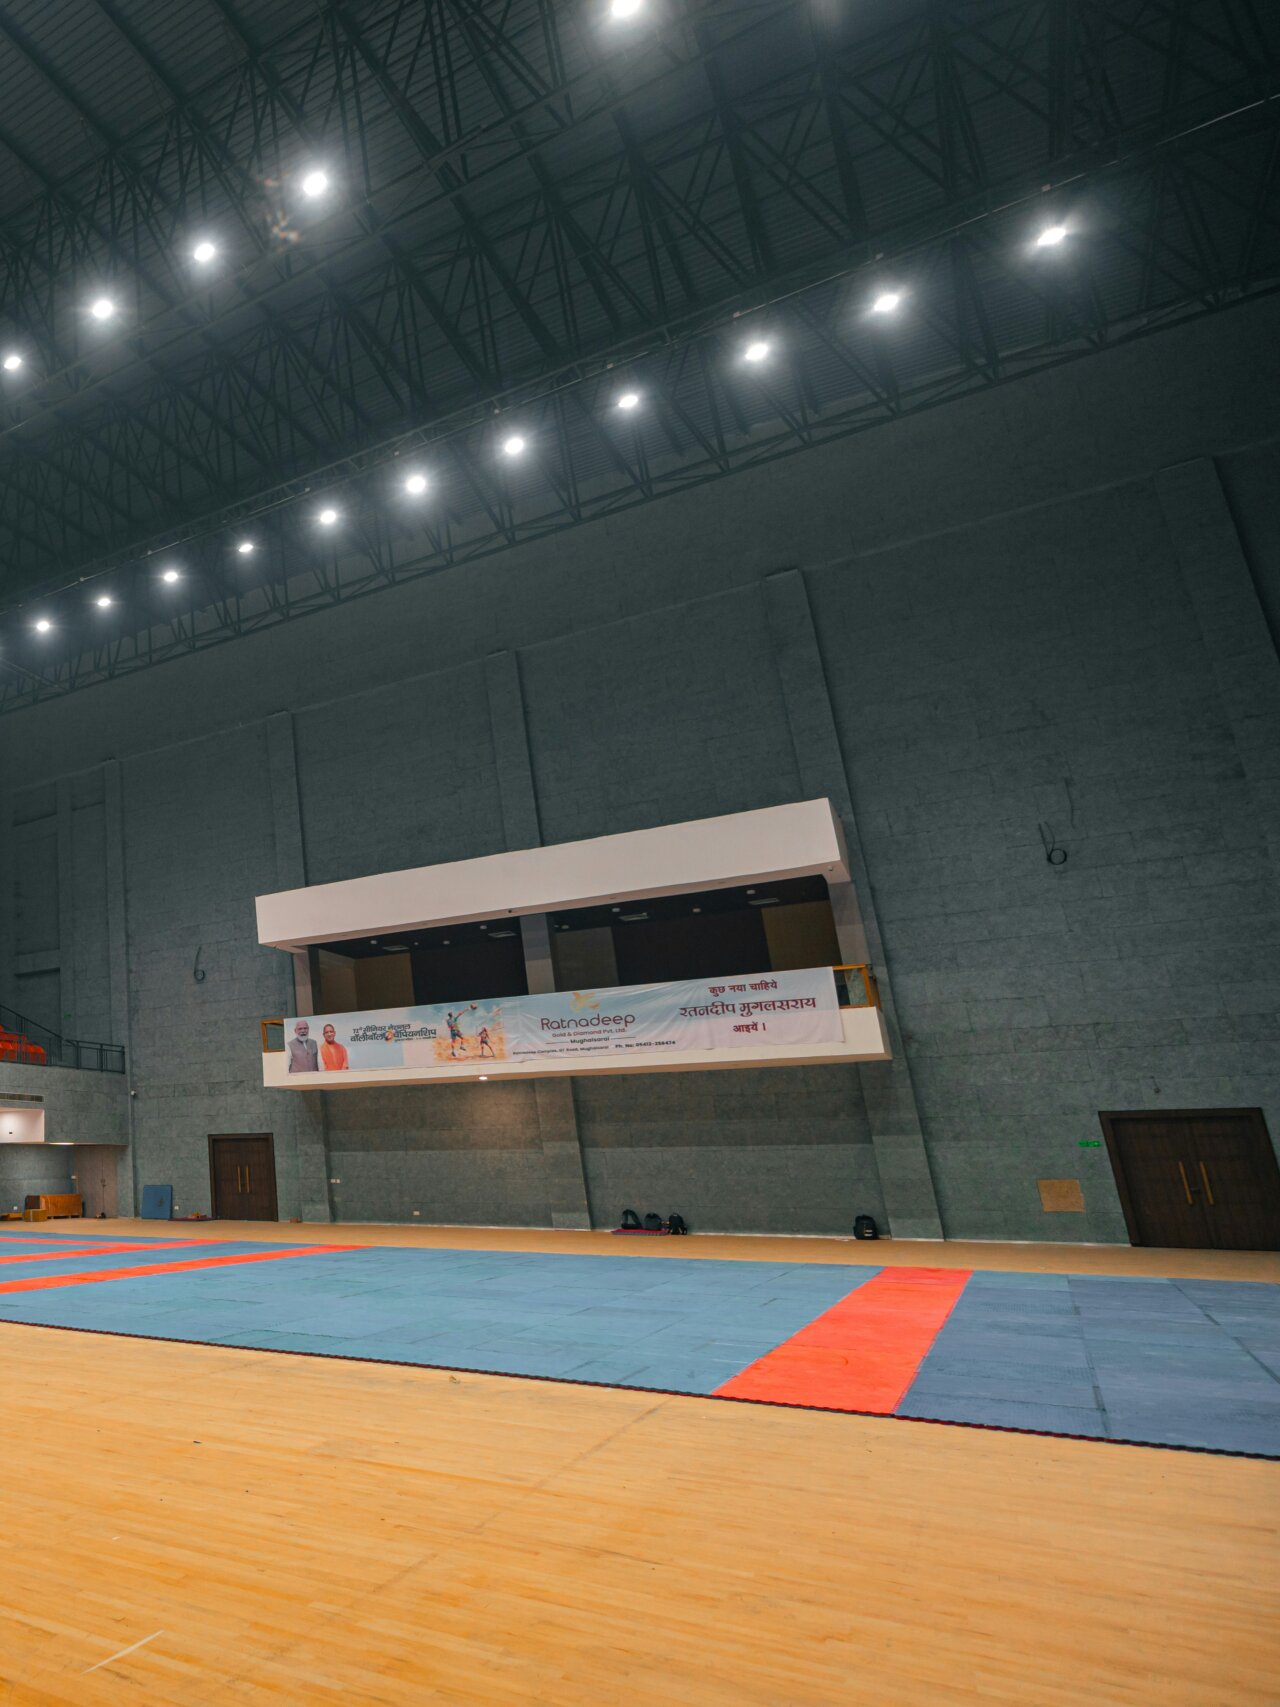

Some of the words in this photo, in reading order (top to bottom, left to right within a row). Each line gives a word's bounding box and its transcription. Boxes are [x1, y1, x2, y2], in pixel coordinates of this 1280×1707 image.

[708, 985, 726, 997] कुछ
[728, 984, 746, 993] नया
[749, 979, 778, 991] चाहिये
[679, 1001, 736, 1017] रतनदीप
[739, 997, 817, 1017] मुगलसराय
[541, 1013, 636, 1031] Ratnadeep
[570, 1036, 610, 1045] Mughalsarai
